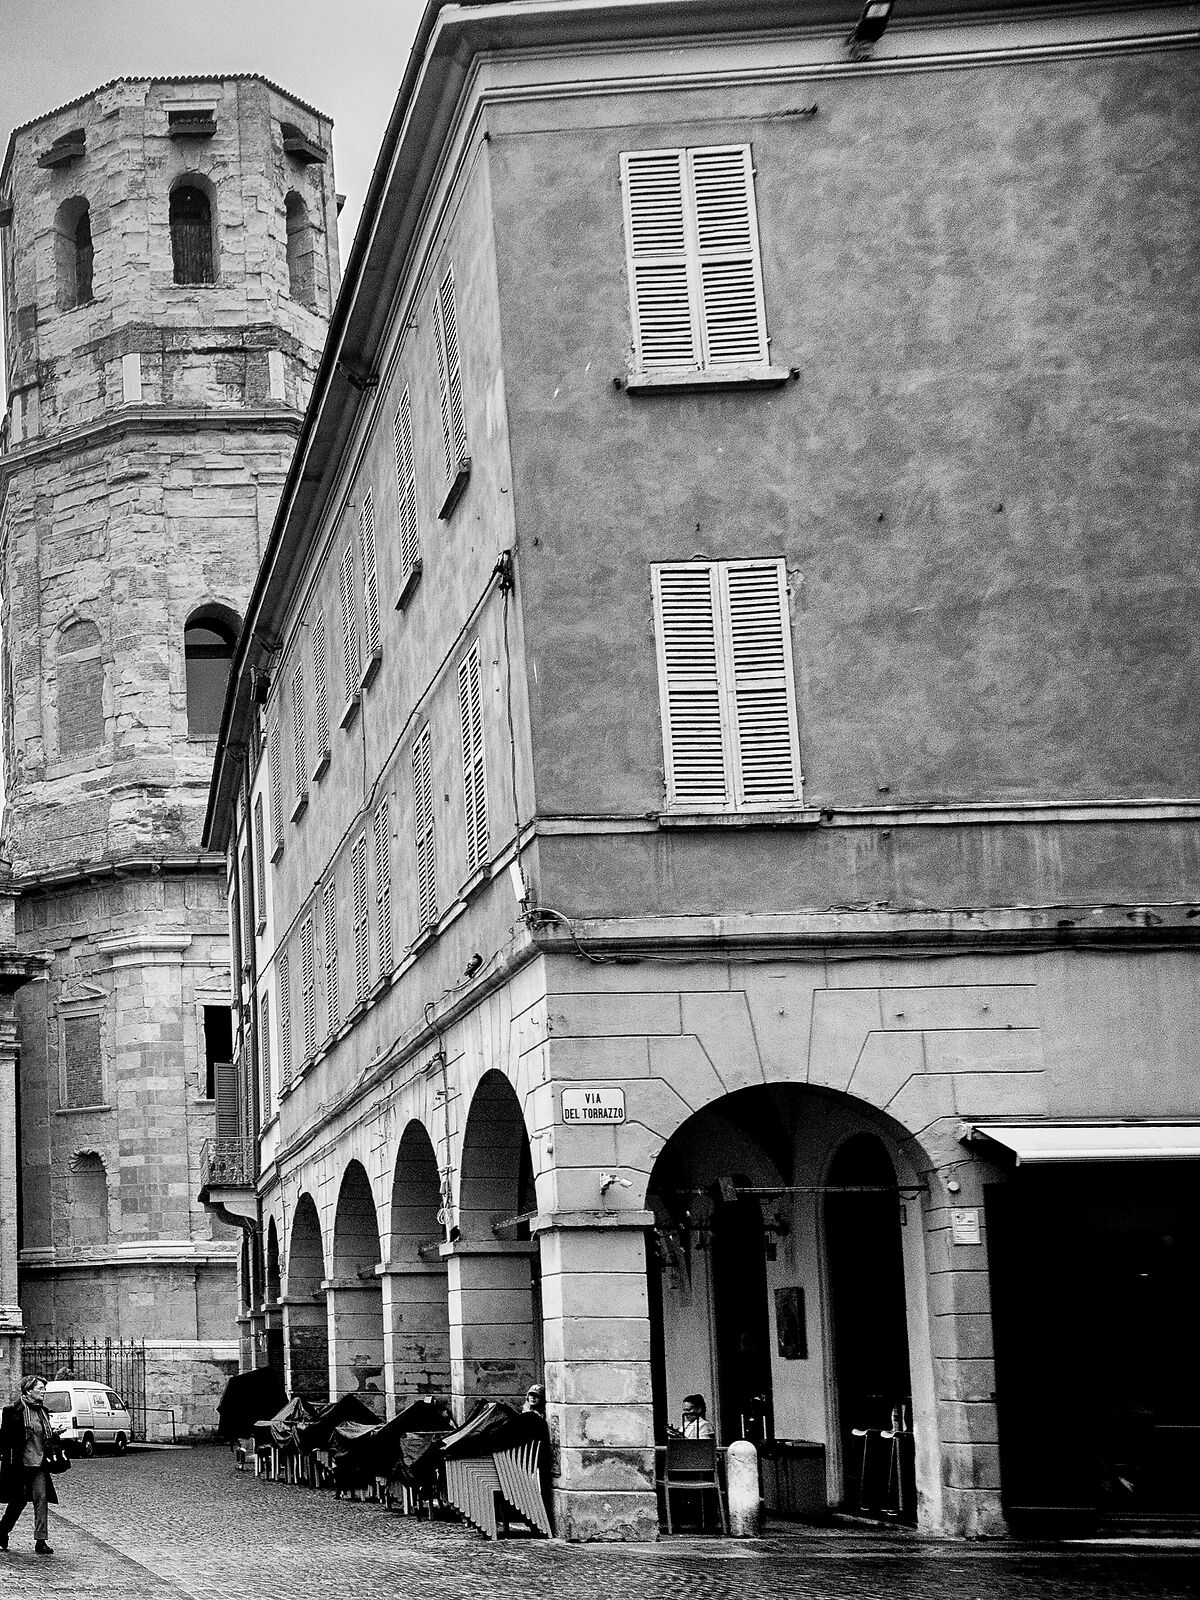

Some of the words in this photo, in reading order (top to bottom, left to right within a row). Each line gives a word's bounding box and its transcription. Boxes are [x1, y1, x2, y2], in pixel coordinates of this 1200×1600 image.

[585, 1093, 602, 1104] VIA
[564, 1108, 580, 1119] DEL
[582, 1107, 624, 1119] TORRAZZO
